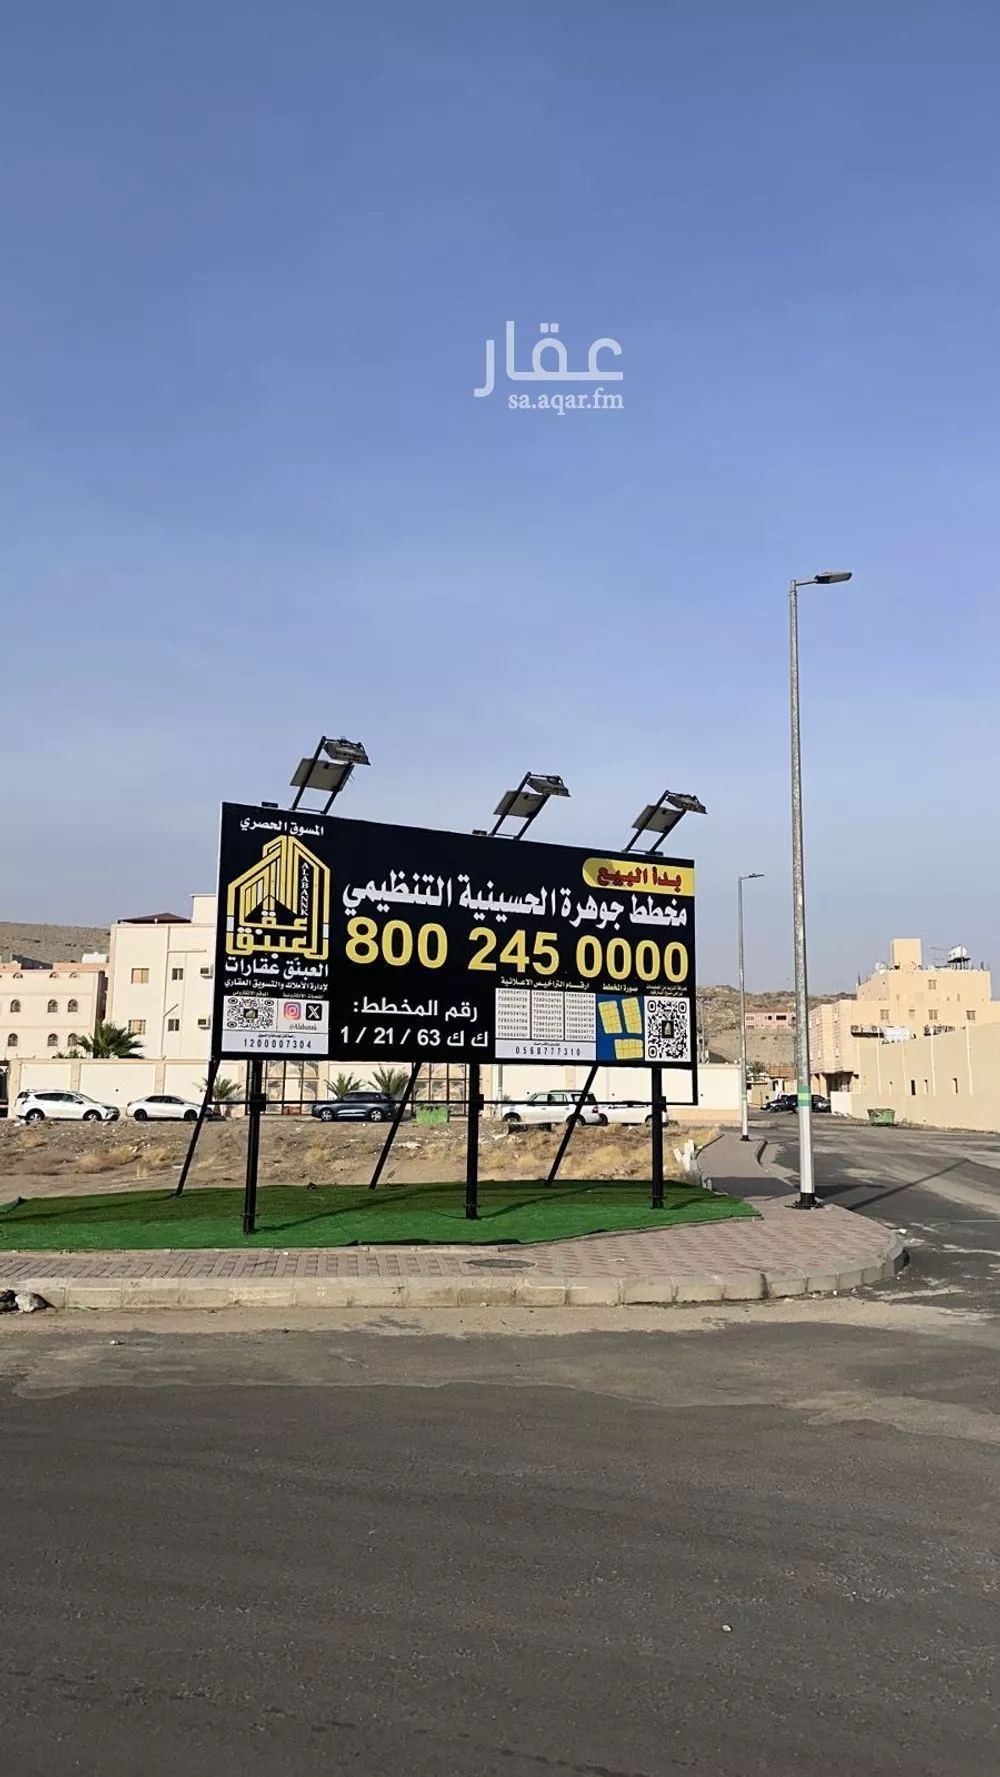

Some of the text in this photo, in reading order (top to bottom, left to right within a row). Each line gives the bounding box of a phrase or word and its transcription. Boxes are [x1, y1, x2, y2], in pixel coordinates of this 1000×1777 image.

[240, 817, 324, 836] المسوق الحصري
[597, 867, 648, 887] البيع
[300, 862, 309, 916] ALABANNK
[342, 869, 687, 930] مخطط جوهرة الحسينية التنظيمي
[345, 916, 688, 983] 800 245 0000
[225, 956, 280, 976] عقارات
[353, 996, 438, 1016] المخطط:
[445, 1001, 478, 1022] رقم
[243, 1038, 312, 1049] 1200007304
[341, 1026, 349, 1043] 1
[373, 1027, 394, 1045] 21
[417, 1029, 441, 1046] 63
[446, 1030, 464, 1047] ك
[471, 1031, 488, 1047] ك
